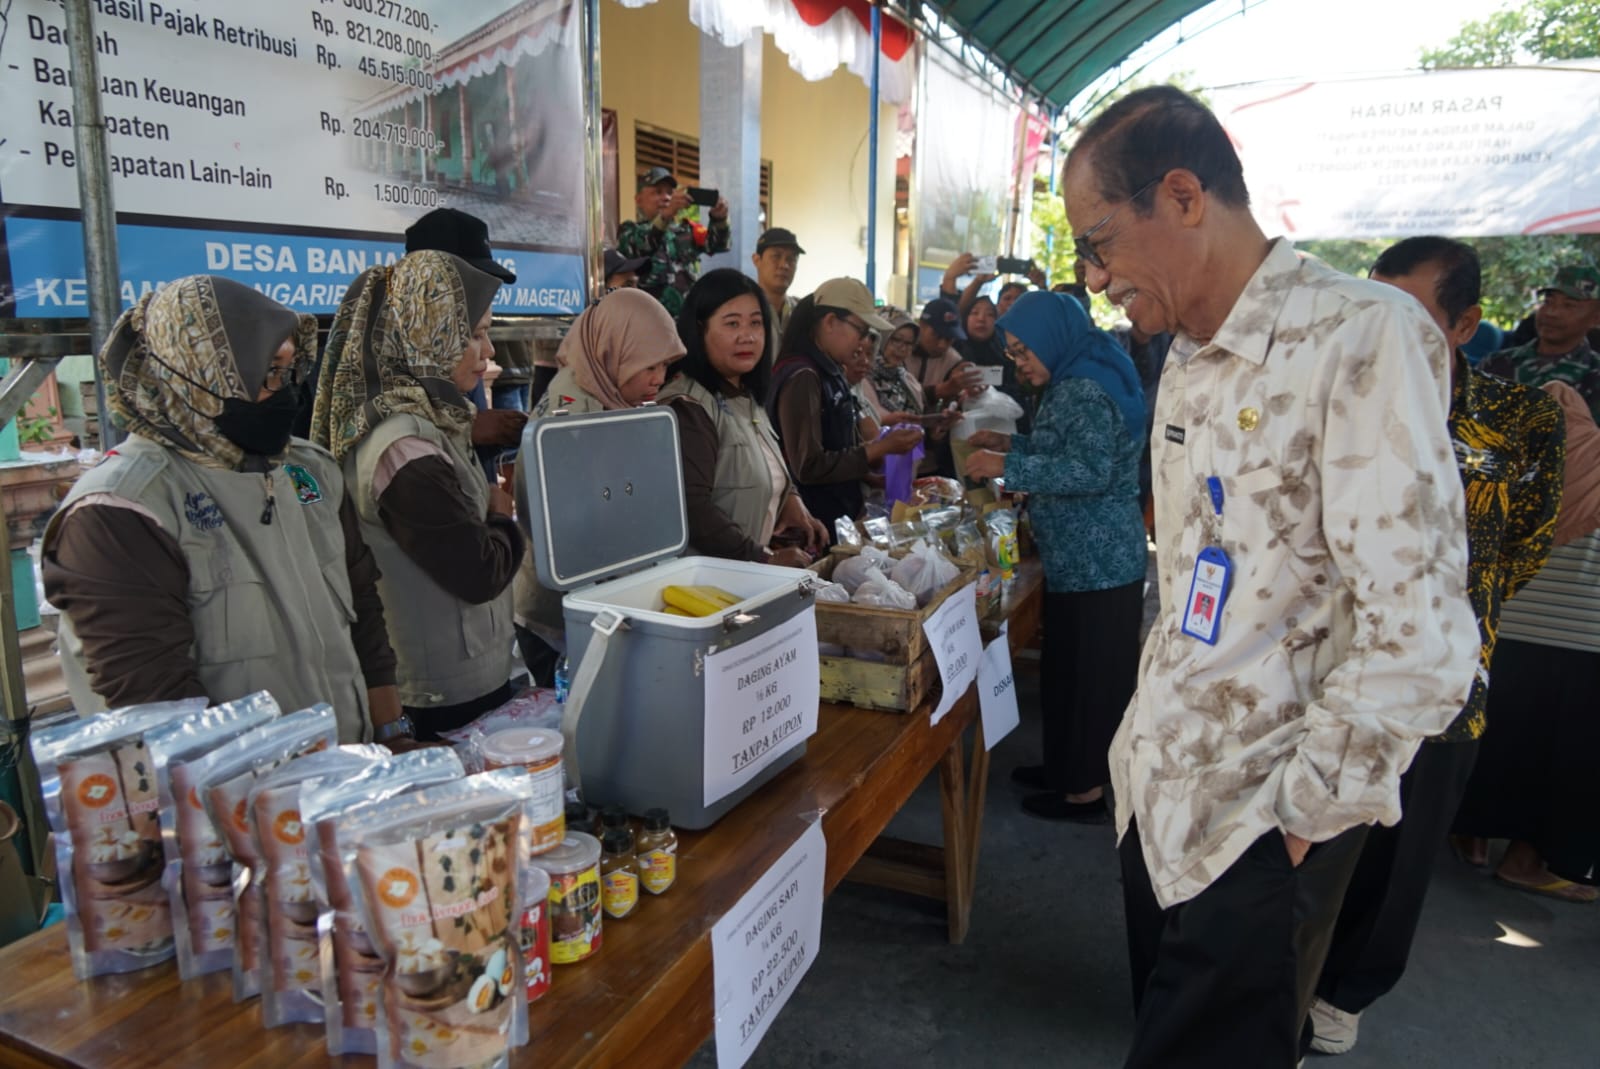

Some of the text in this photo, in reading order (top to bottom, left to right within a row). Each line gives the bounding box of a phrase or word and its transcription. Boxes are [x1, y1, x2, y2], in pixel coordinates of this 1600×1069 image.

[150, 3, 209, 37] Pajak
[213, 18, 297, 58] Retribusi
[312, 11, 339, 37] Rp.
[316, 44, 342, 70] Rp.
[143, 77, 246, 117] Keuangan
[39, 100, 169, 141] Kapaten
[320, 111, 345, 136] Rp.
[44, 141, 184, 180] Peapatan
[190, 159, 272, 189] Lain-lain
[325, 177, 350, 200] Rp.
[205, 242, 298, 273] DESA
[515, 288, 580, 307] MAGETAN
[737, 663, 772, 691] DAGING
[773, 648, 797, 673] AYAM
[742, 694, 791, 735] RP 12.000
[731, 711, 803, 771] TANPA KUPON
[745, 879, 799, 946] DAGING SAPI
[739, 941, 806, 1039] TANPA KUPON
[752, 969, 765, 996] RP
